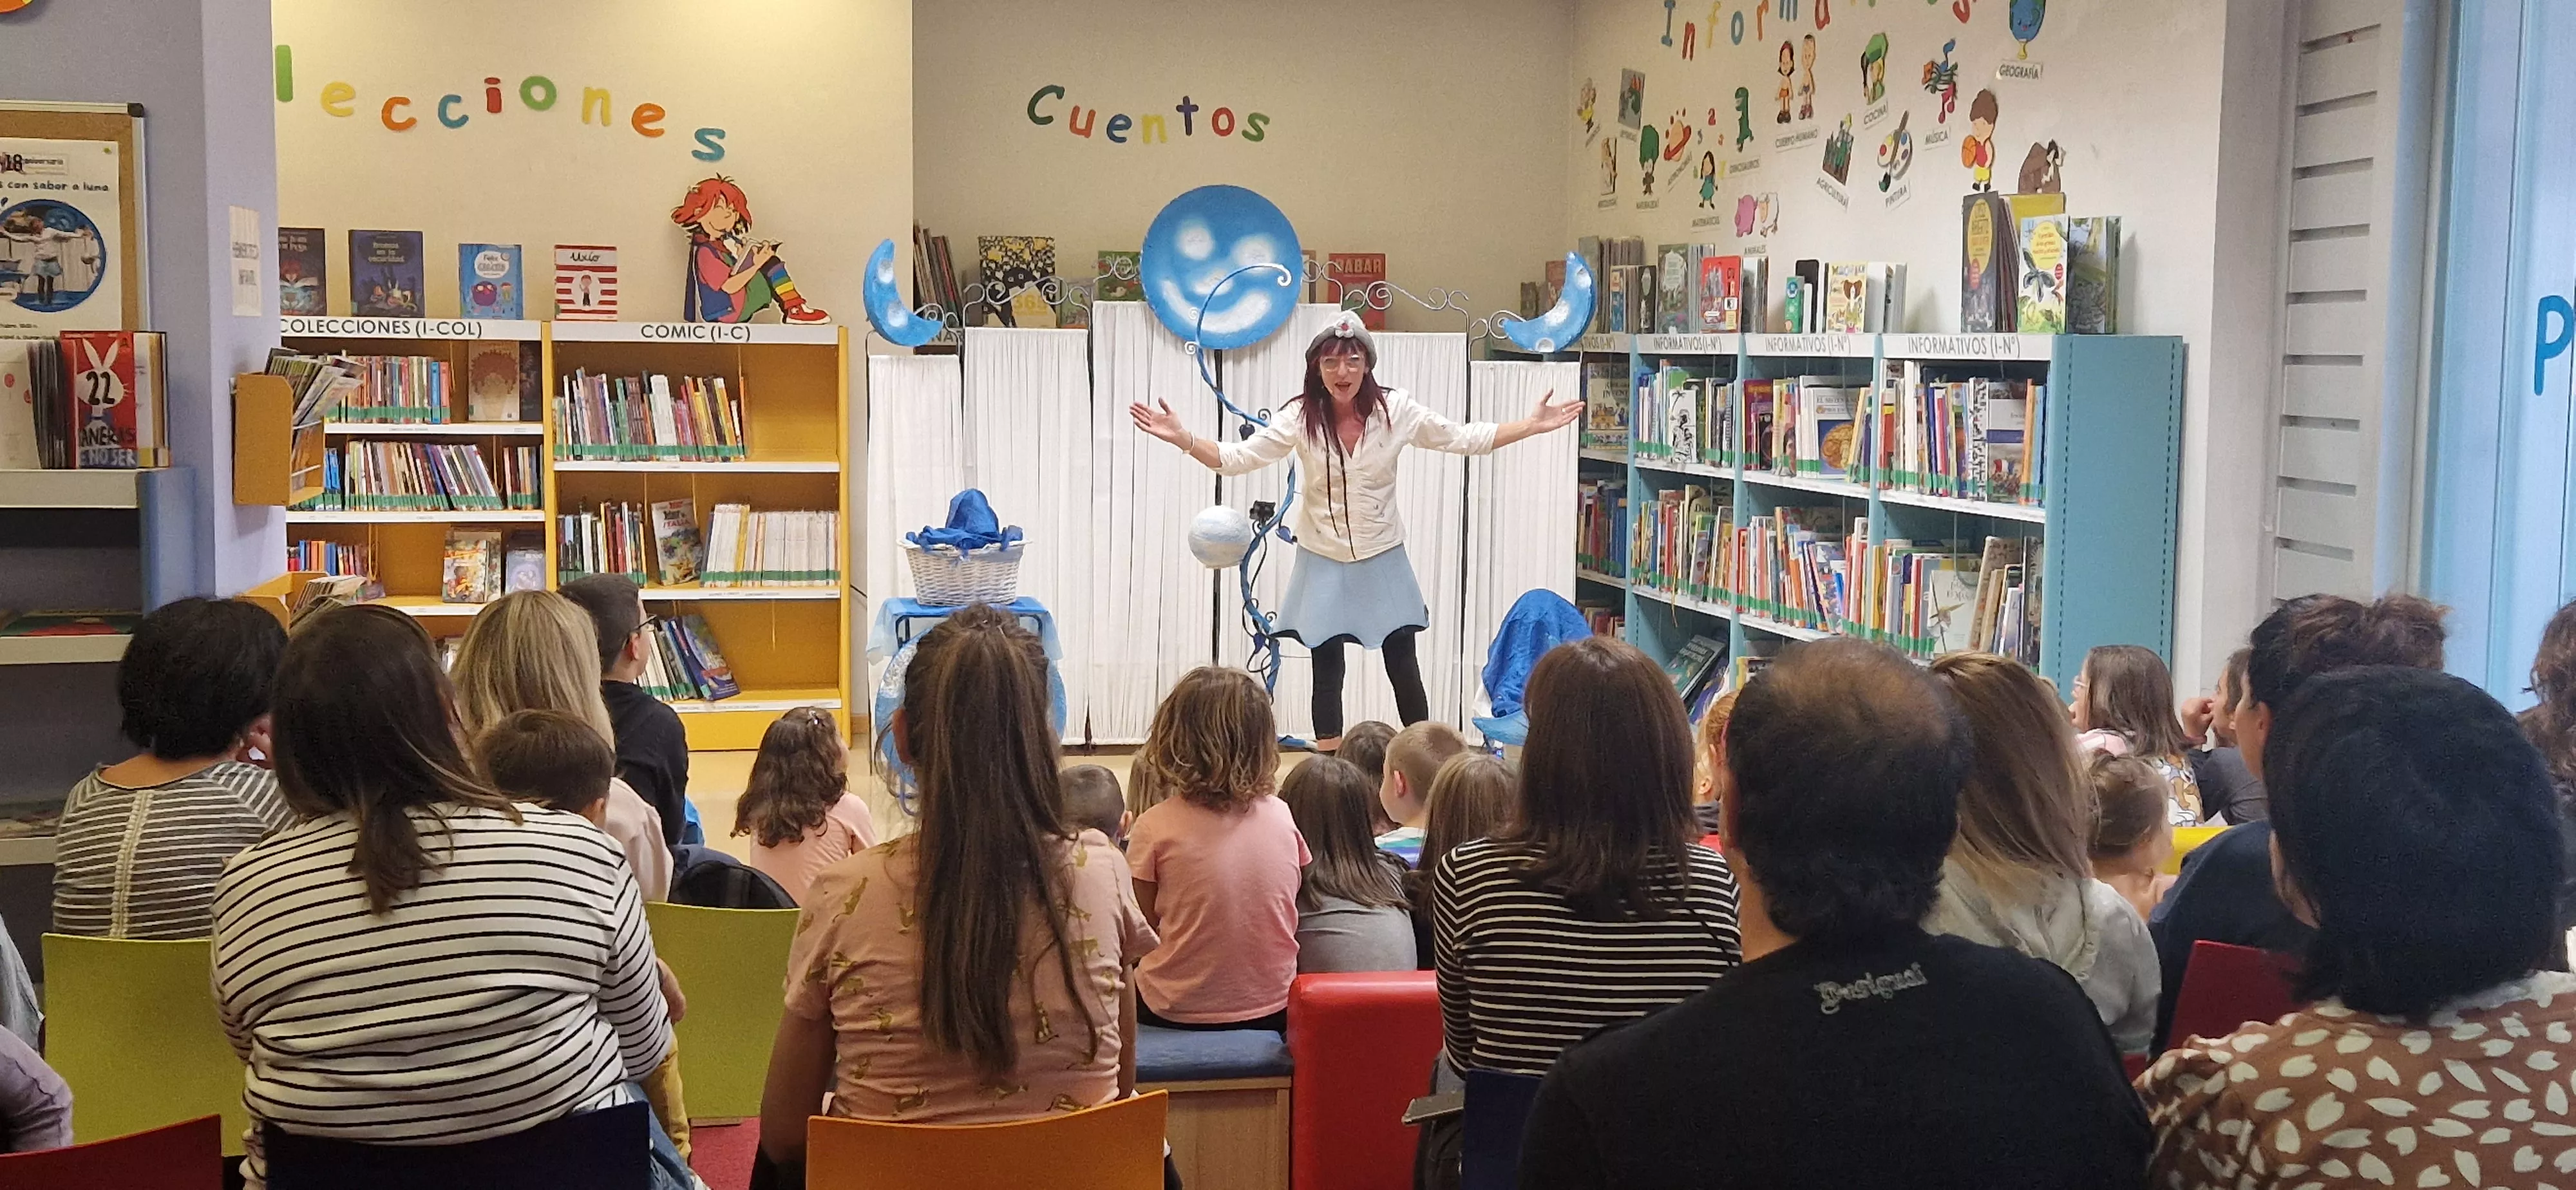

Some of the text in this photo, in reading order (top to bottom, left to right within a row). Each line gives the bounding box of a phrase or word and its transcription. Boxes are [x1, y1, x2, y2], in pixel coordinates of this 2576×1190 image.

[2000, 64, 2039, 80] GEOGRAFÍA
[1027, 84, 1271, 144] Cuentos
[33, 180, 68, 190] sabor
[83, 182, 109, 191] luna
[1335, 258, 1383, 274] BABAR
[280, 319, 482, 338] COLECCIONES (I-COL)
[641, 325, 751, 343] COMIC (I-C)
[1654, 336, 1702, 351] INFORMATIVOS
[1765, 336, 1826, 352] INFORMATIVOS
[1908, 337, 1987, 355] INFORMATIVOS
[86, 371, 115, 406] 22
